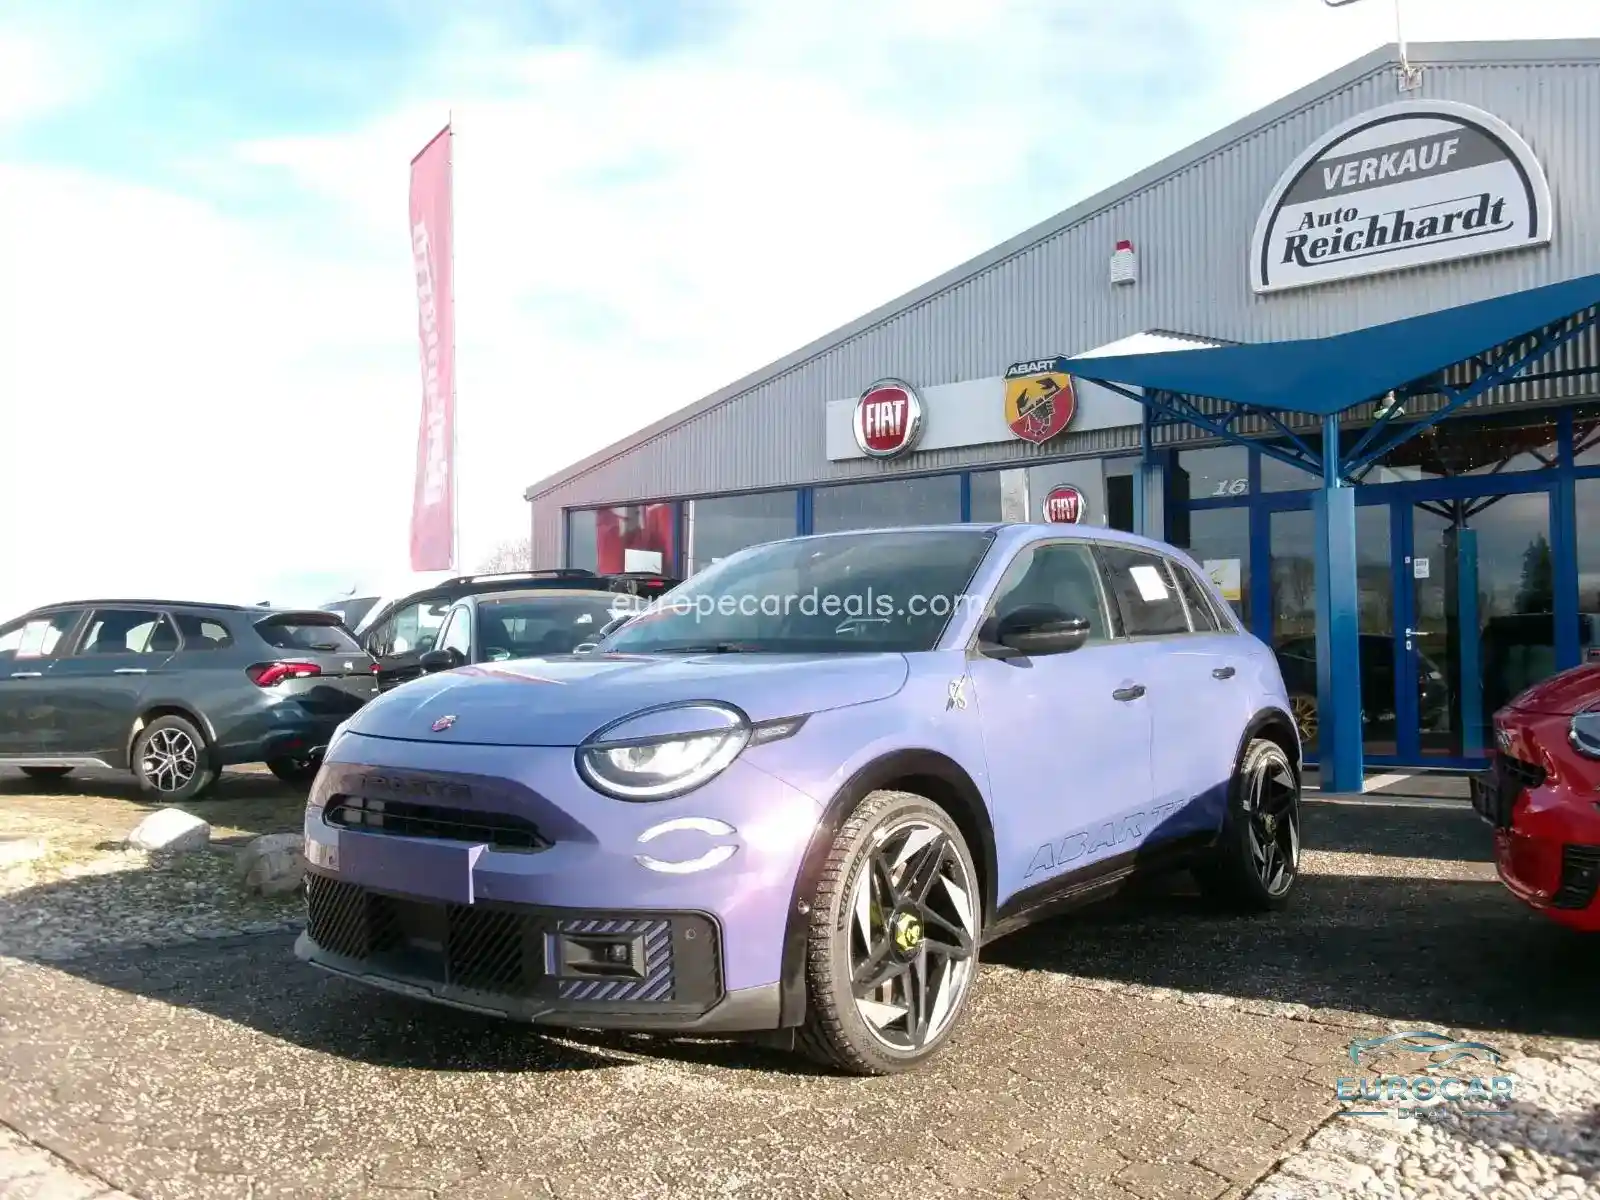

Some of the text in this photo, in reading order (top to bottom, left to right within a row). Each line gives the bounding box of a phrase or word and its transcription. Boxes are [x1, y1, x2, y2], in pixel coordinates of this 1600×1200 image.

[1322, 137, 1461, 191] VERKAUF
[1280, 193, 1512, 267] Reichhardt
[1298, 206, 1359, 231] Auto
[1008, 360, 1057, 376] ABART
[866, 399, 905, 438] FIAT
[1211, 478, 1249, 496] 16
[1050, 497, 1077, 521] FIAT
